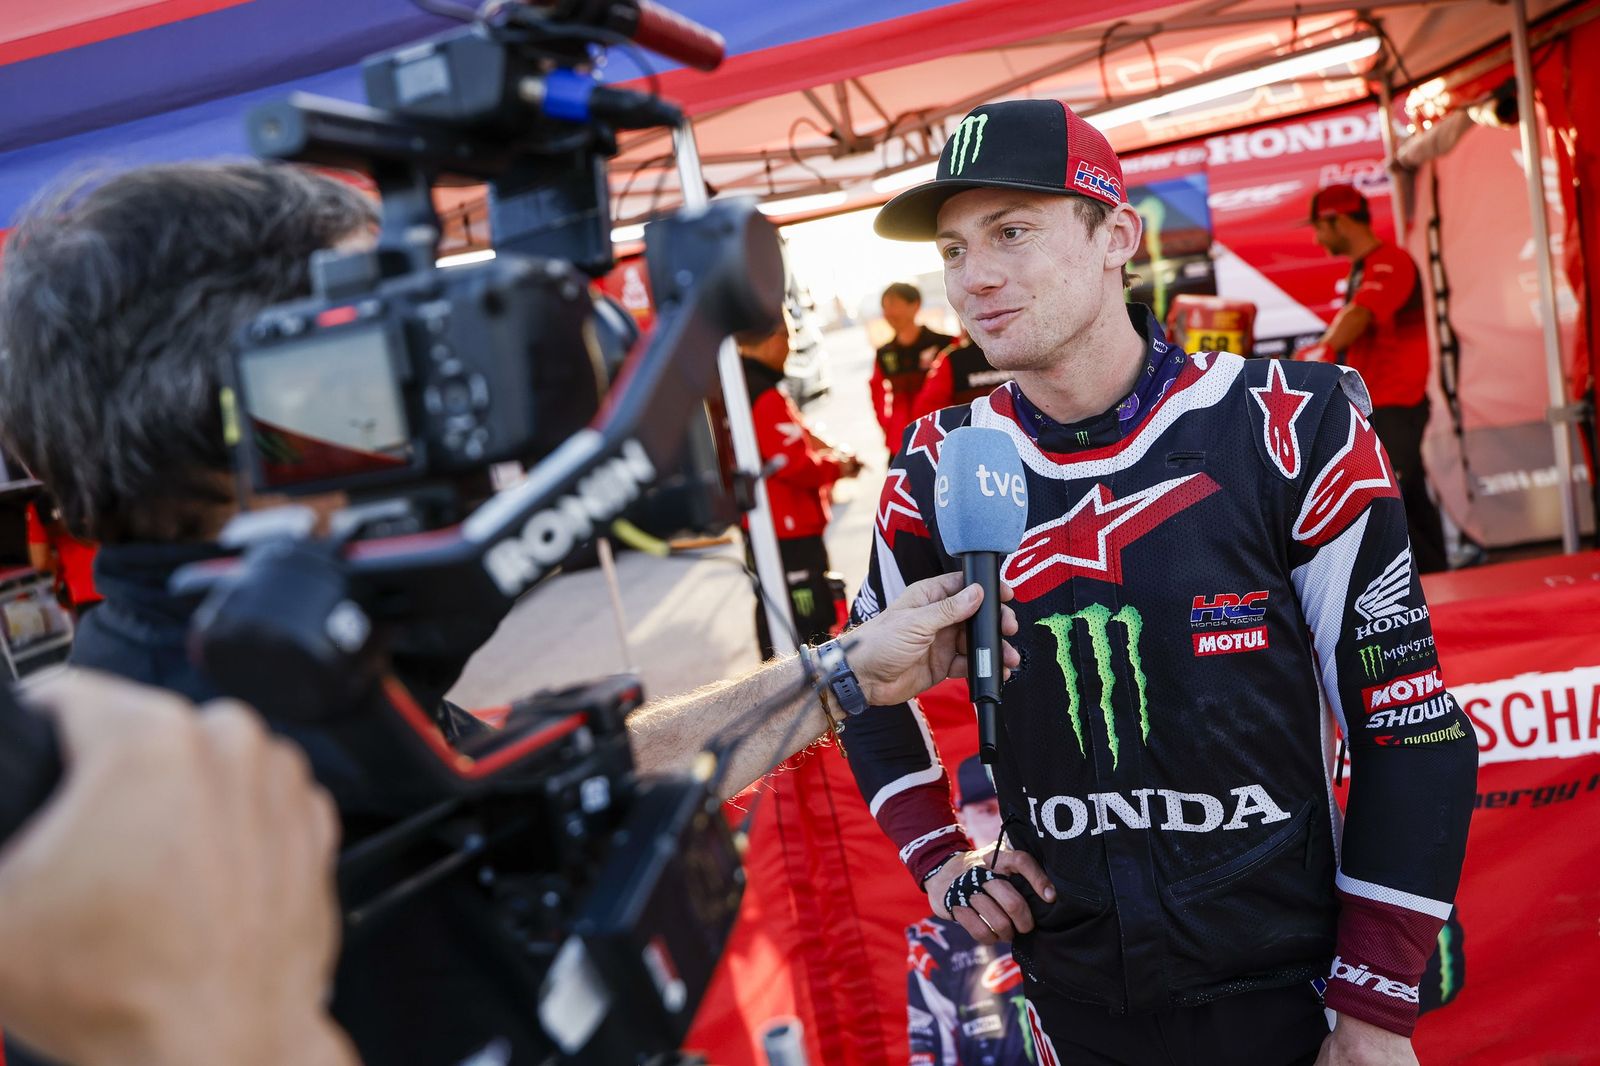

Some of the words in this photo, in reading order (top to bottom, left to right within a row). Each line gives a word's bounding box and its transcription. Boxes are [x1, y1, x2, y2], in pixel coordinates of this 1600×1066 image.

[1075, 160, 1121, 201] HRC
[975, 464, 1026, 507] tve
[1190, 590, 1270, 622] HRC
[1229, 616, 1264, 625] RACING
[1355, 604, 1430, 641] HONDA
[1198, 630, 1266, 653] MOTUL
[1365, 692, 1454, 729] SHOWA
